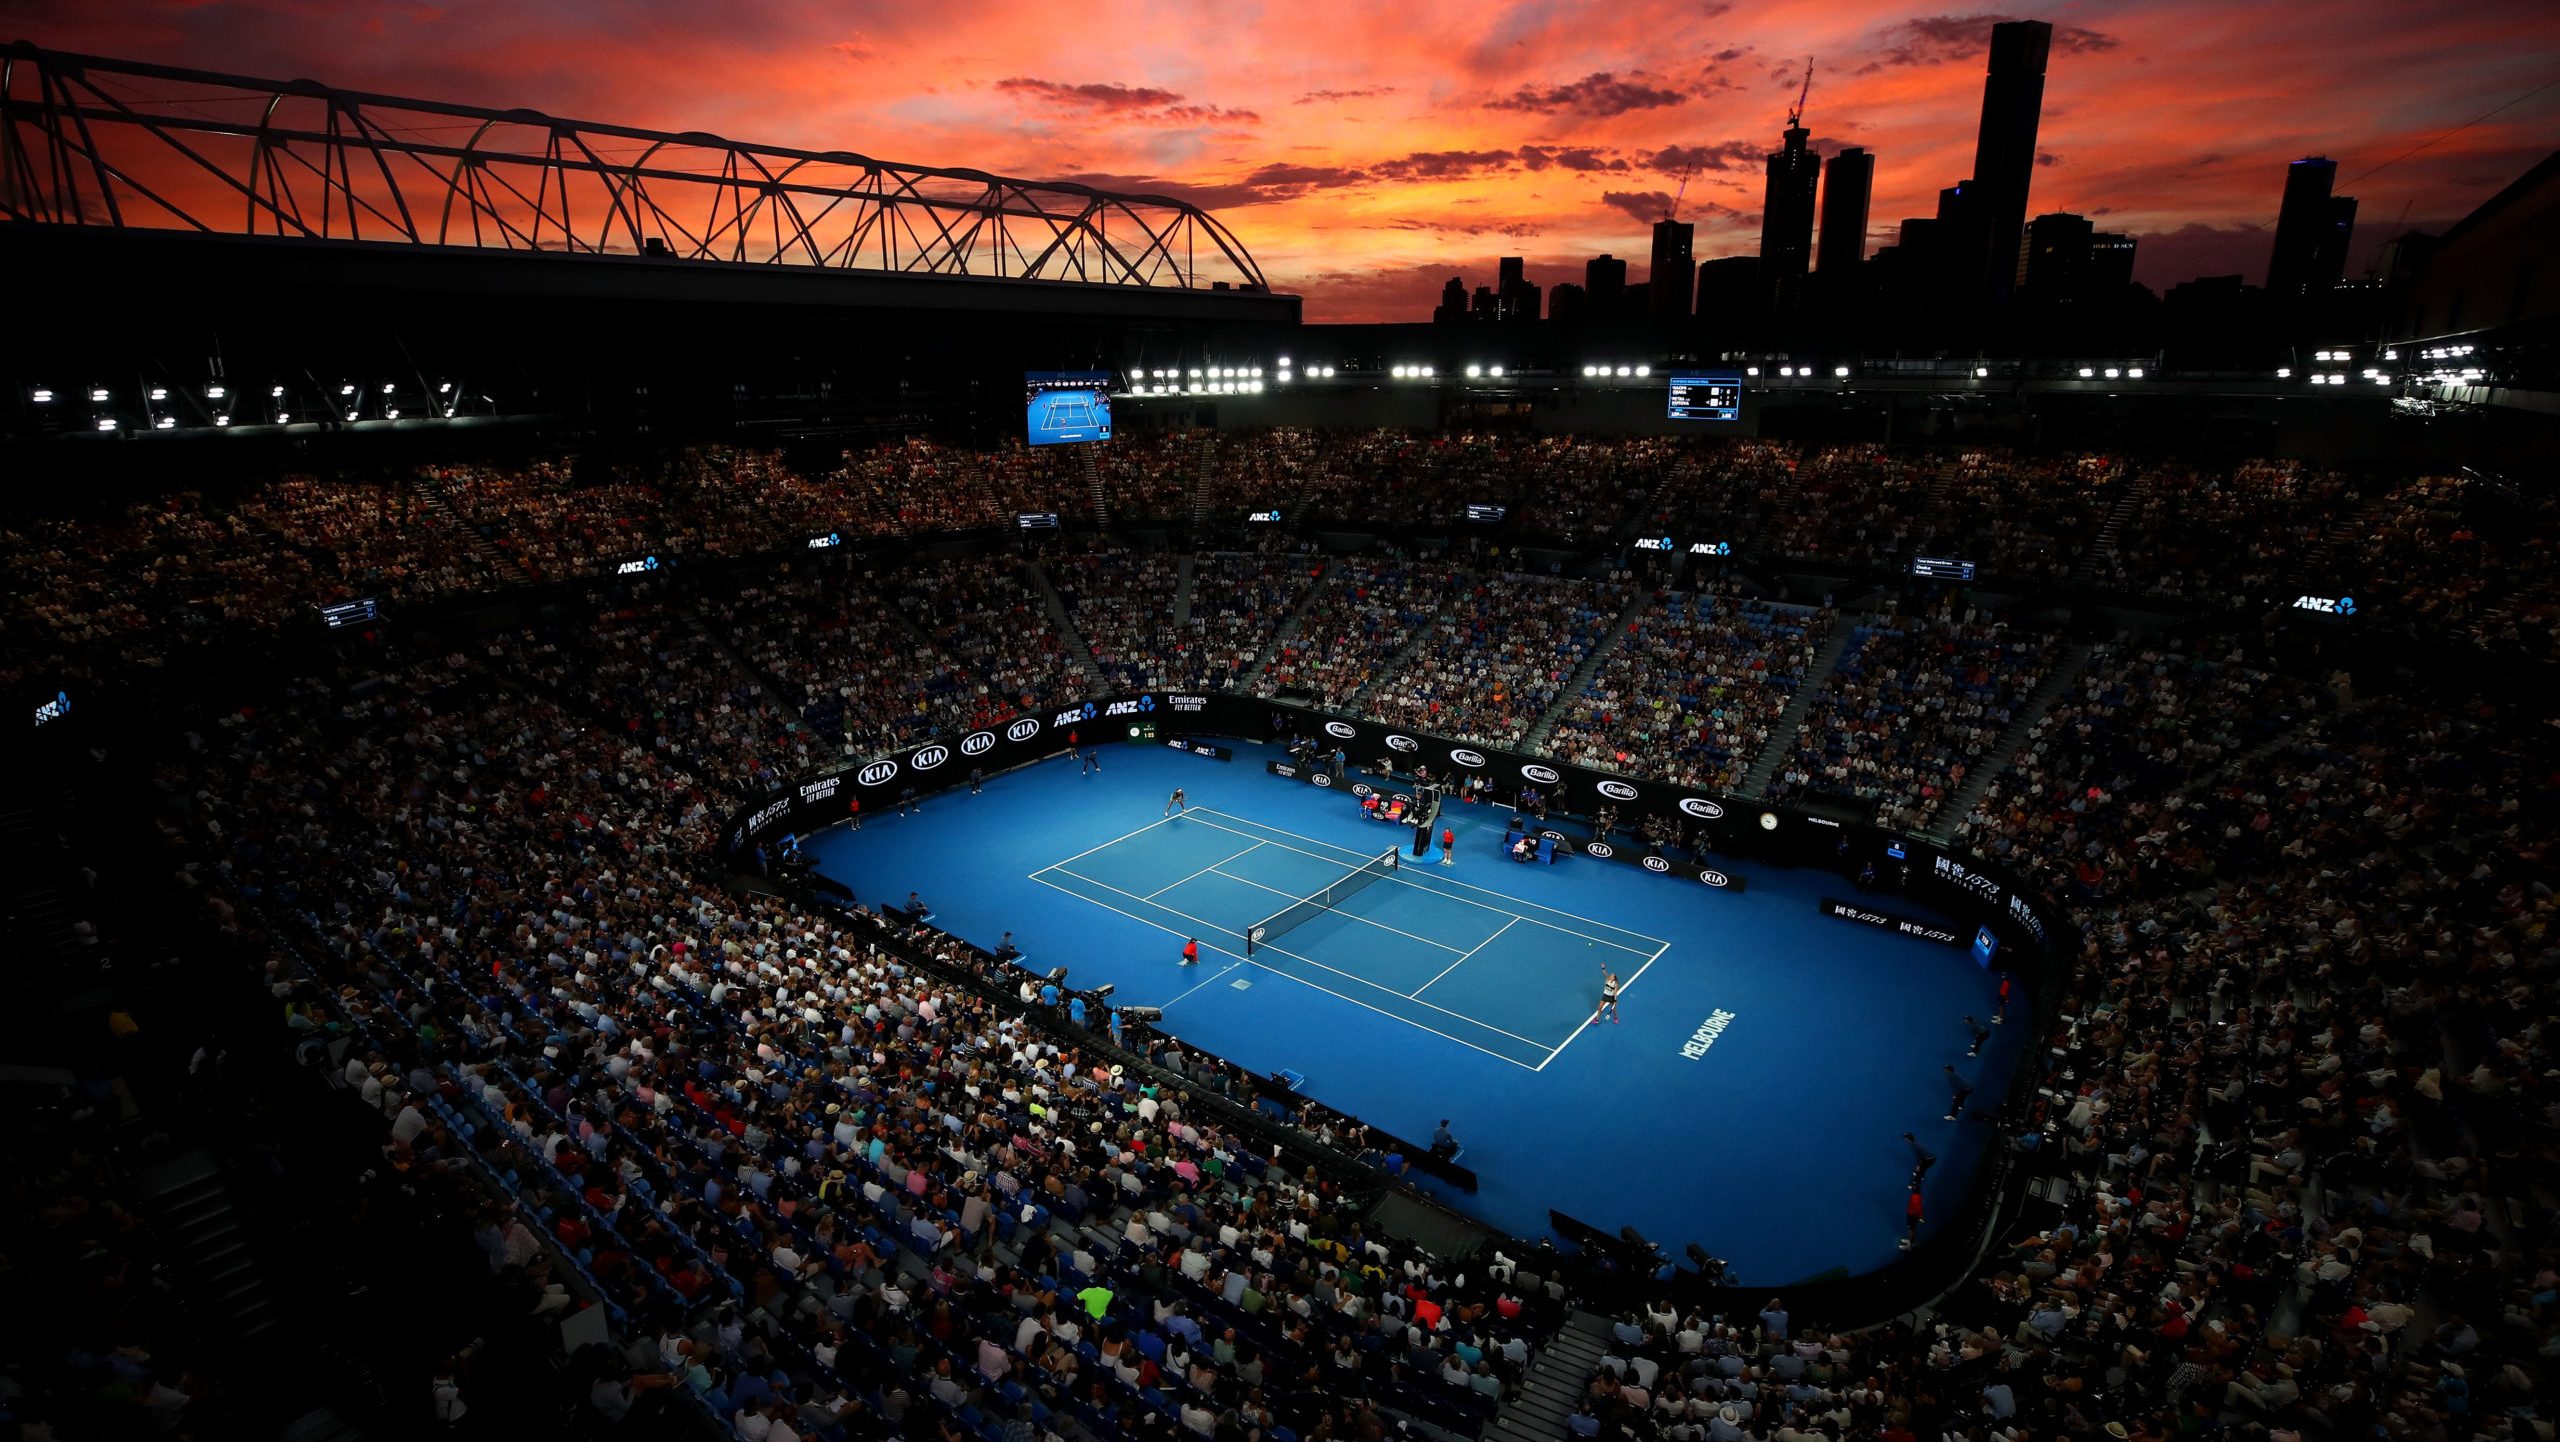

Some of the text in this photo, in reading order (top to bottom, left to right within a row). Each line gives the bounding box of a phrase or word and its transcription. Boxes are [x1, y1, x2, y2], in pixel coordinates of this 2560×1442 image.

[1248, 512, 1270, 521] ANZ
[808, 537, 829, 548] ANZ
[1634, 538, 1660, 550] ANZ
[1690, 543, 1717, 555] ANZ
[617, 560, 645, 574] ANZ
[2292, 595, 2335, 613] ANZ
[1169, 695, 1207, 705] Emirates
[1105, 701, 1138, 716] ANZ
[1053, 709, 1081, 728] ANZ
[1012, 722, 1035, 738] KIA
[1332, 724, 1353, 736] Barilla
[966, 736, 990, 753] KIA
[1168, 739, 1181, 749] ANZ
[1194, 746, 1209, 756] ANZ
[917, 750, 942, 767] KIA
[1458, 753, 1483, 765] Barilla
[864, 765, 891, 783] KIA
[1315, 775, 1328, 785] KIA
[1529, 768, 1556, 781] Barilla
[800, 776, 840, 797] Emirates
[1605, 785, 1635, 798] Barilla
[815, 787, 835, 800] BETTER
[1688, 801, 1721, 816] Barilla
[1808, 817, 1840, 828] MELBOURNE
[1592, 844, 1608, 856] KIA
[1648, 858, 1665, 871] KIA
[1704, 872, 1723, 885] KIA
[1678, 1008, 1736, 1061] MELBOURNE
